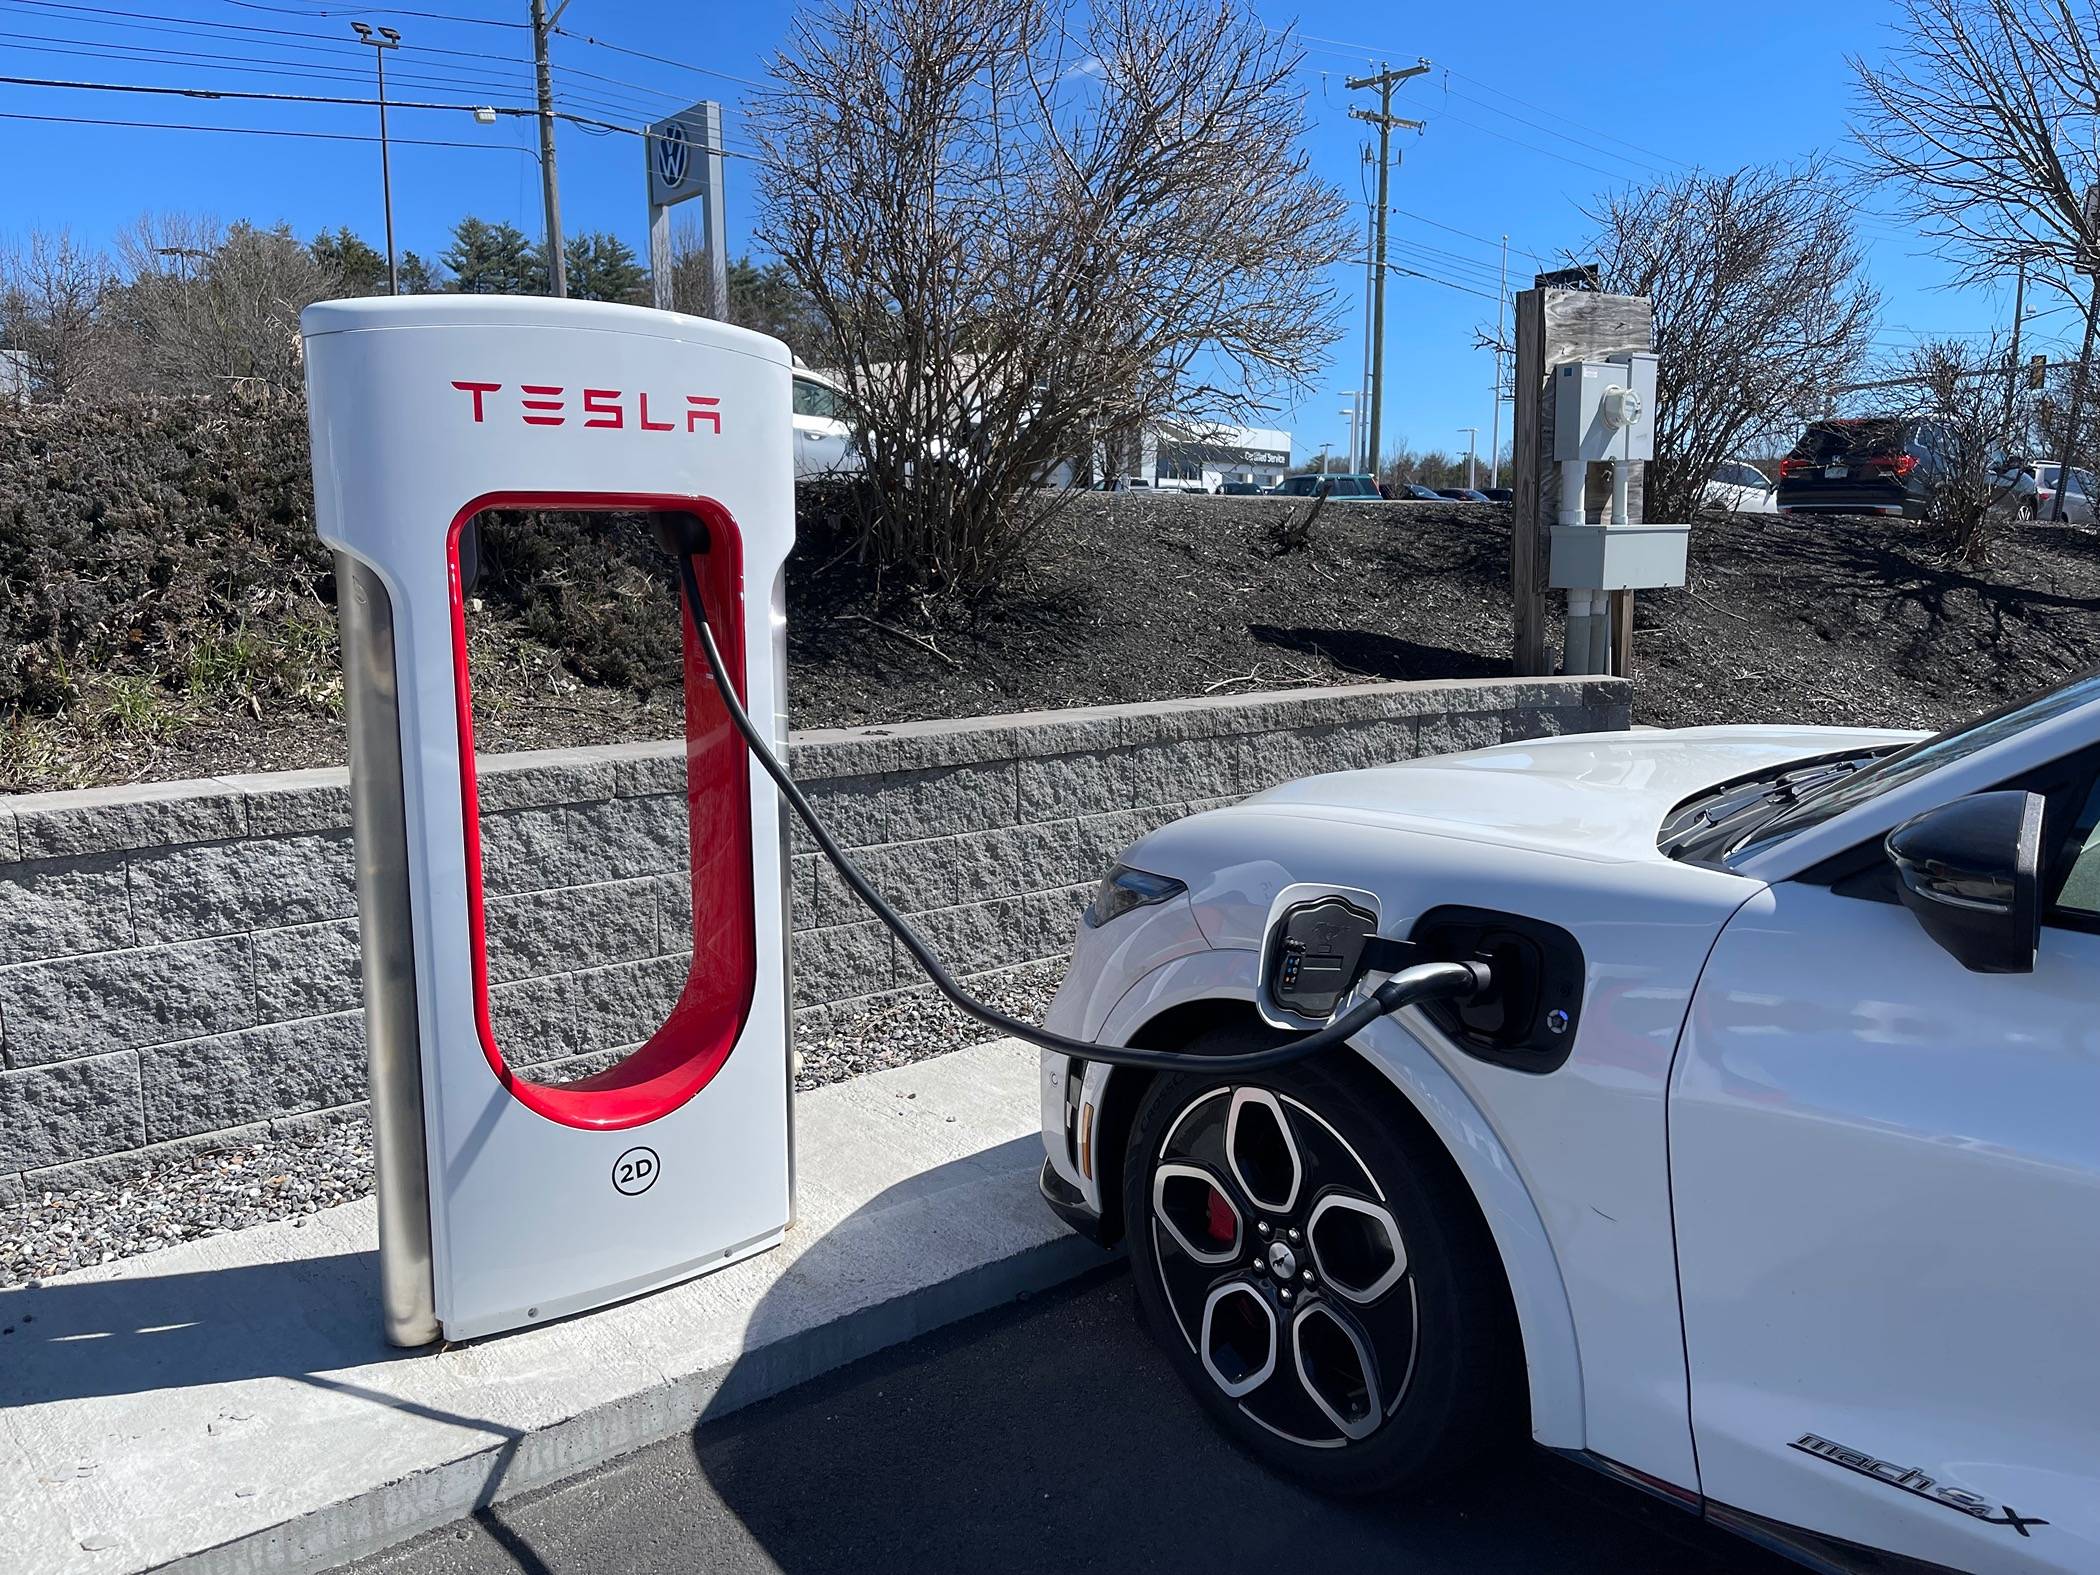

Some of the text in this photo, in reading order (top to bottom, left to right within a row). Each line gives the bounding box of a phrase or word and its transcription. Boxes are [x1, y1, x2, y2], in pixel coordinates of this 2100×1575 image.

[451, 381, 721, 435] TESLA
[1267, 453, 1286, 464] Service
[620, 1159, 653, 1184] 2D
